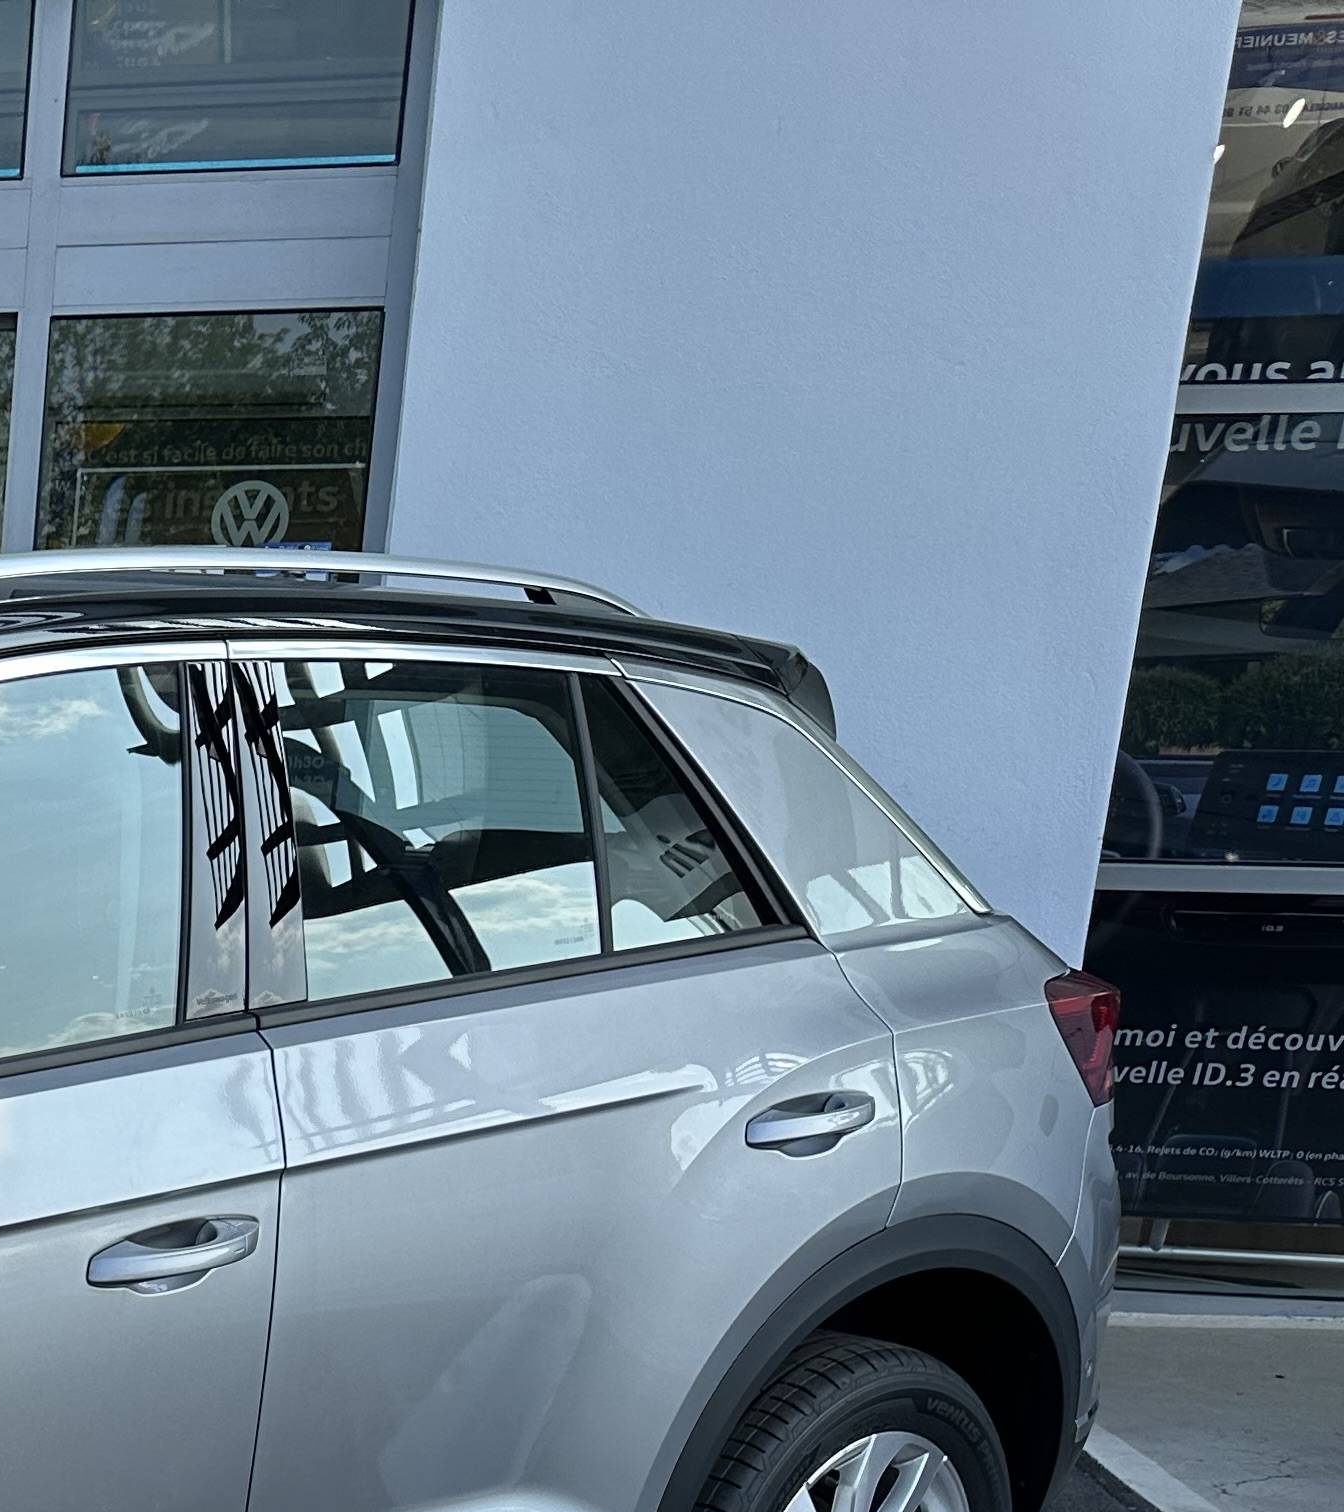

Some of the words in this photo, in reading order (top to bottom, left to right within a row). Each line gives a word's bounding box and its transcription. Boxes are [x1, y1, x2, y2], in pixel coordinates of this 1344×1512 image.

[1114, 1023, 1178, 1049] moi
[1184, 1026, 1220, 1049] et
[1192, 1061, 1256, 1087] ID.3
[1262, 1069, 1300, 1089] en
[1147, 1144, 1181, 1159] Rejets
[1183, 1145, 1197, 1156] de
